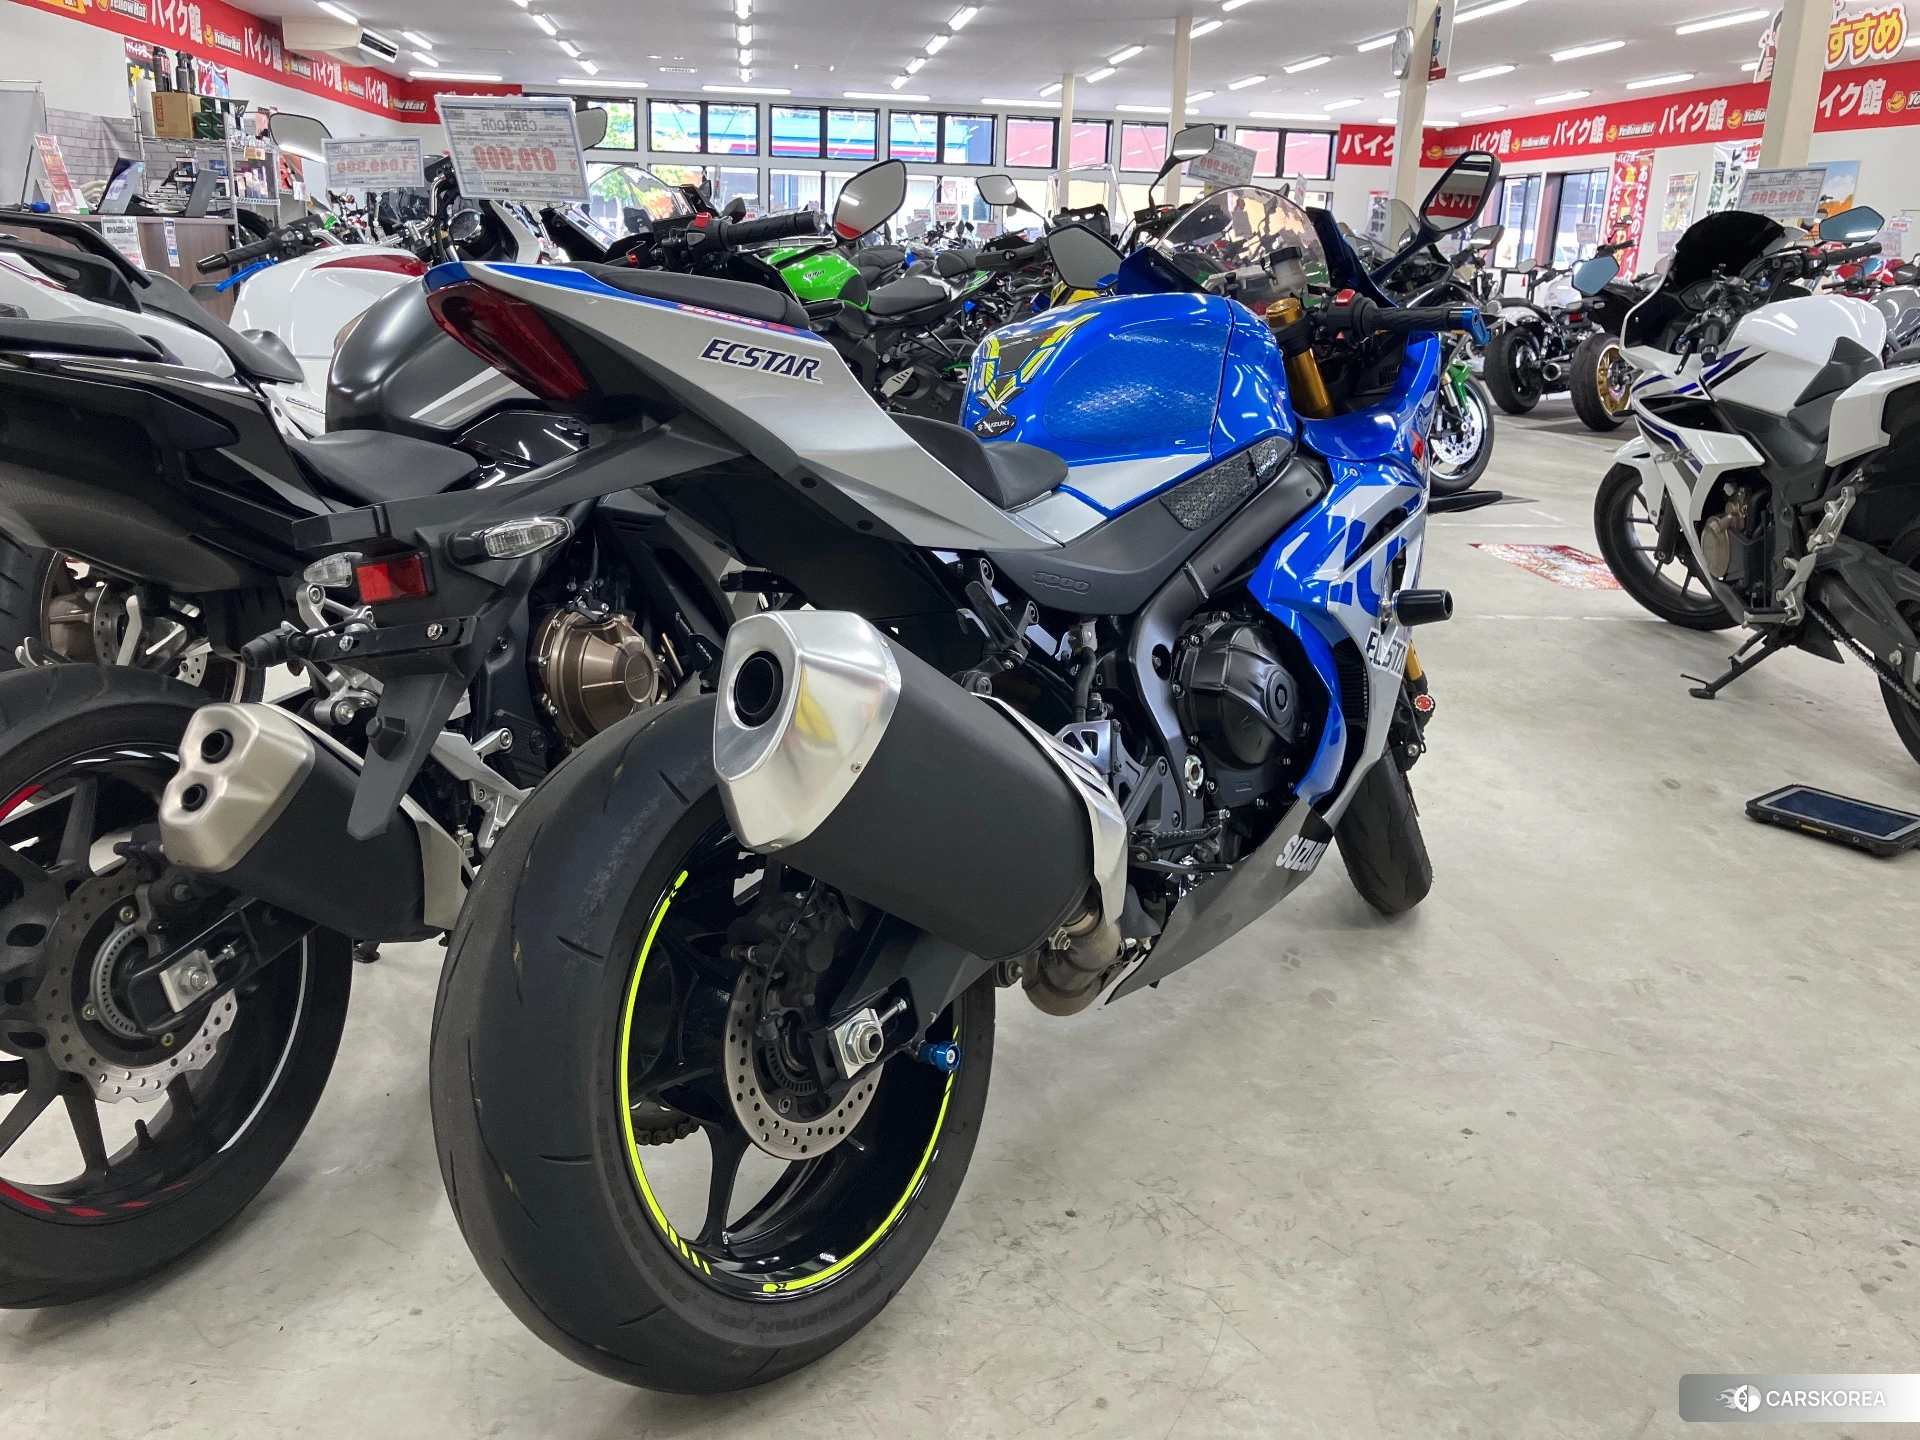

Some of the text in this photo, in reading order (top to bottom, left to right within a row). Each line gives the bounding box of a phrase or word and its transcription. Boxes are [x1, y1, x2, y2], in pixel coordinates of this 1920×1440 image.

[1553, 115, 1607, 147] バイク館
[1659, 98, 1728, 134] バイク館
[700, 339, 822, 382] ECSTAR
